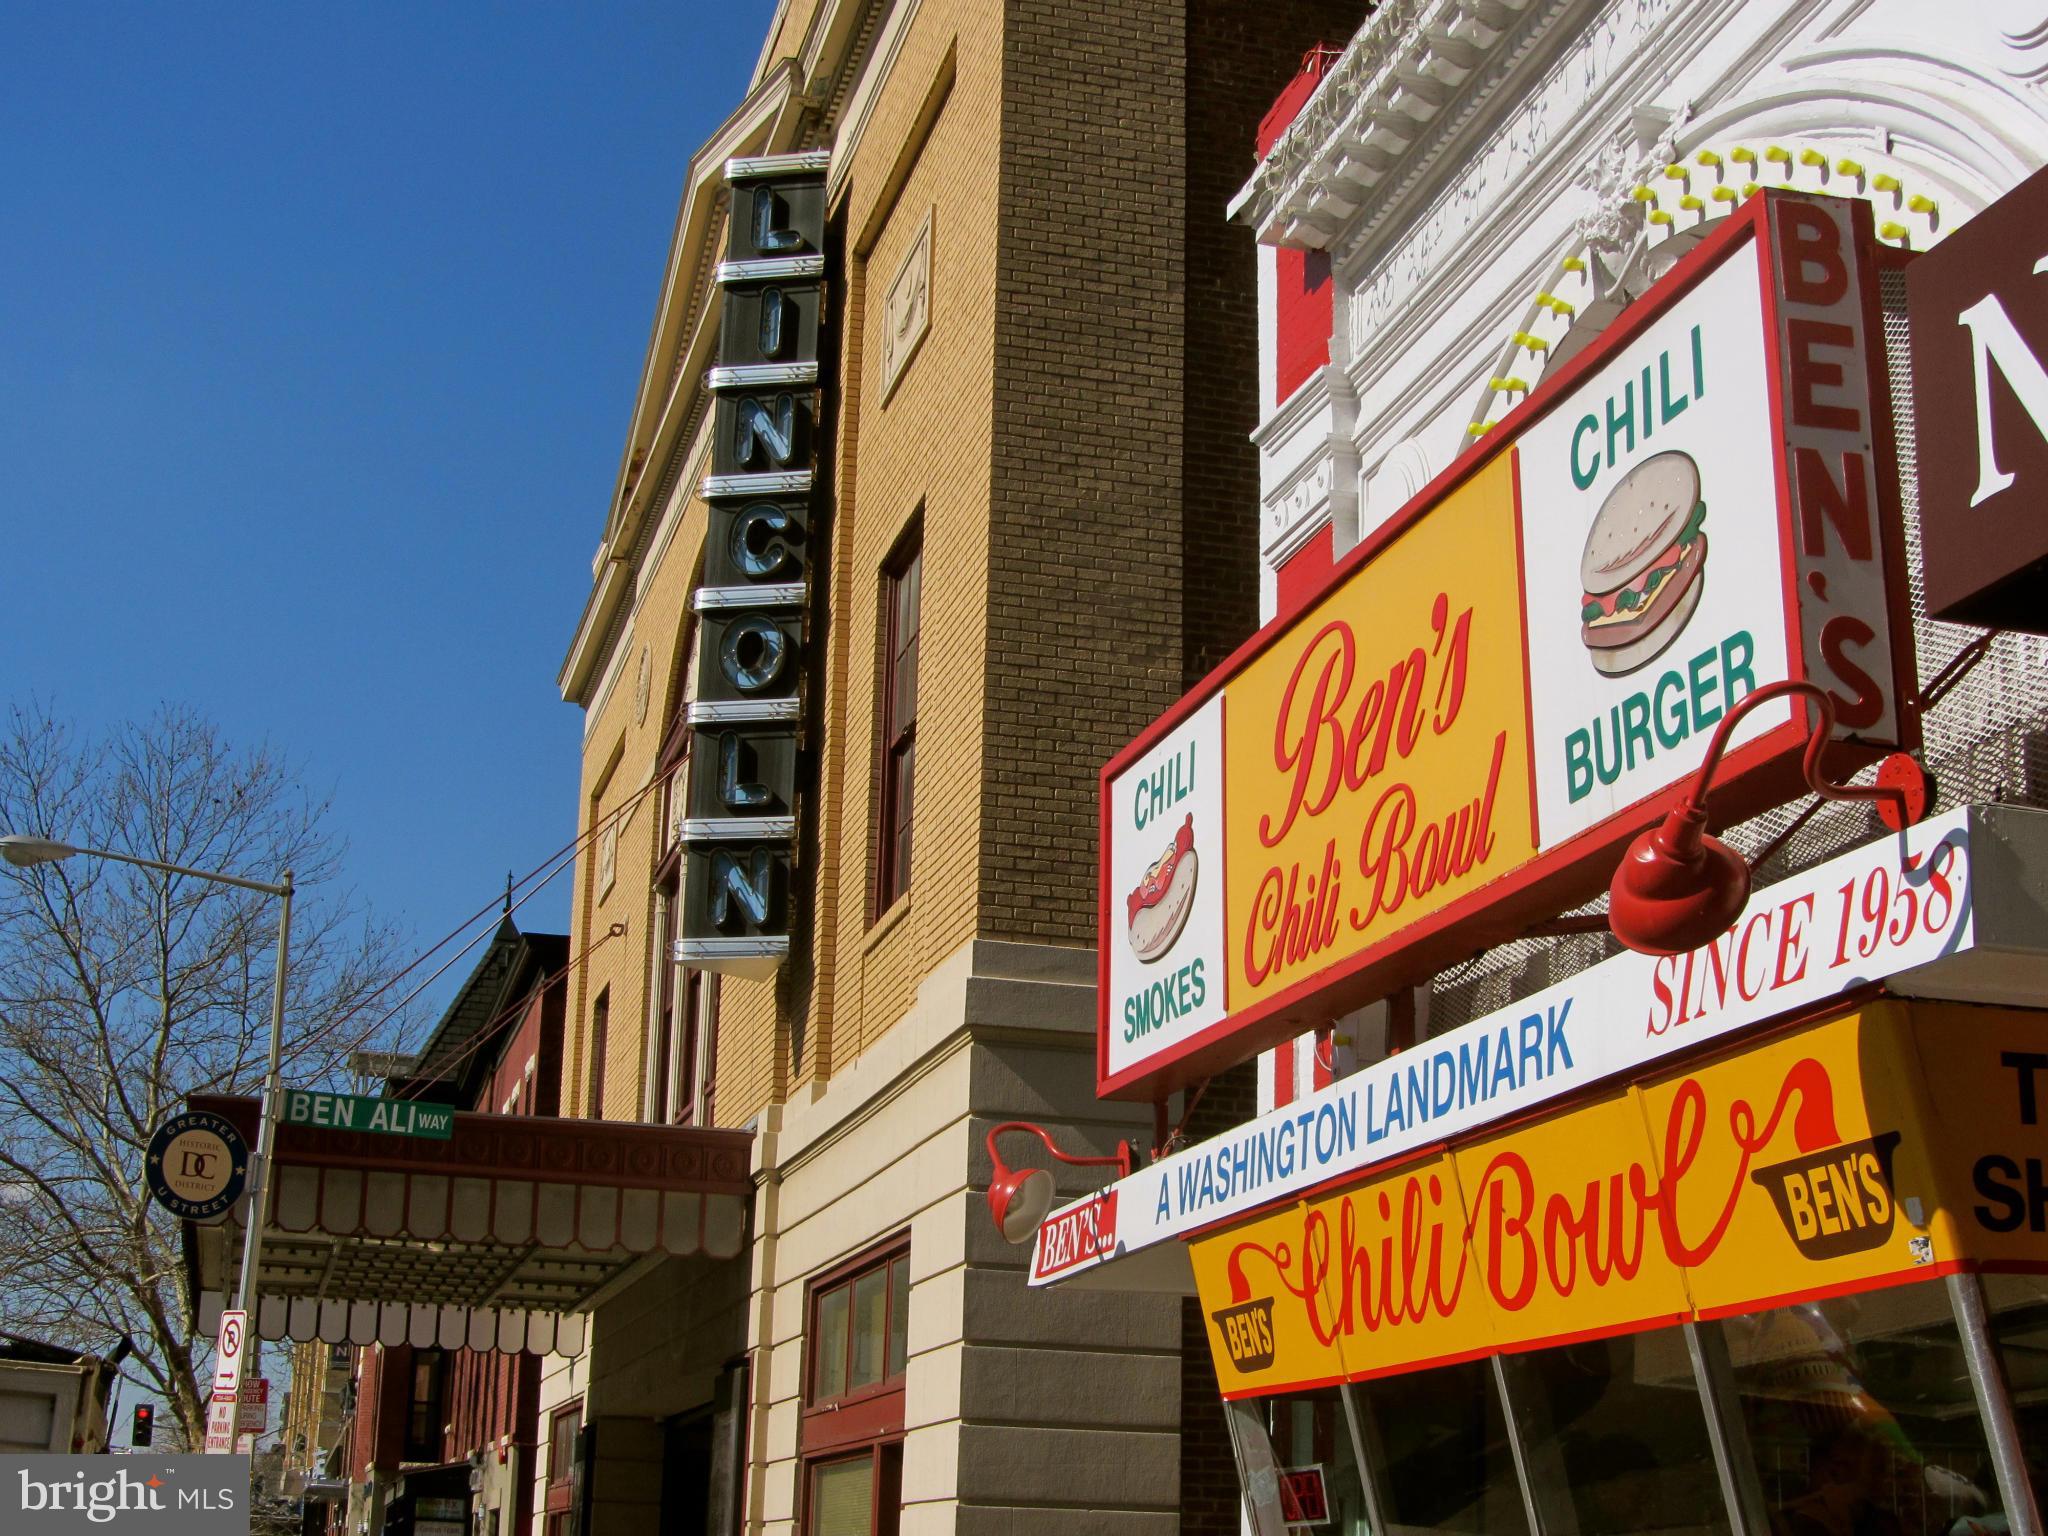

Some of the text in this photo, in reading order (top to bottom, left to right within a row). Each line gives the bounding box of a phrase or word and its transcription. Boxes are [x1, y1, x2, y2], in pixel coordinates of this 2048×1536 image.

[1570, 325, 1704, 491] CHILI
[1777, 203, 1884, 731] BEN'S
[708, 183, 803, 927] LINCOLN
[1259, 592, 1473, 848] Ben's
[1564, 629, 1757, 805] BURGER
[1134, 740, 1197, 831] CHILI
[1244, 730, 1507, 987] Chili Bowl
[1124, 957, 1206, 1044] SMOKES
[1155, 840, 1955, 1224] A WASHINGTON LANDMARK SINCE 1958
[166, 1117, 237, 1142] GREATER
[180, 1140, 220, 1151] HISTORIC
[290, 1093, 449, 1133] BEN ALI WAY
[158, 1187, 229, 1214] U STREET
[175, 1181, 215, 1192] DISTRICT
[180, 1151, 217, 1179] DC
[1785, 1147, 1890, 1242] BEN'S
[1270, 1078, 1752, 1347] Chili Bowl
[1226, 1307, 1275, 1361] BEN'S
[219, 1406, 227, 1419] NO
